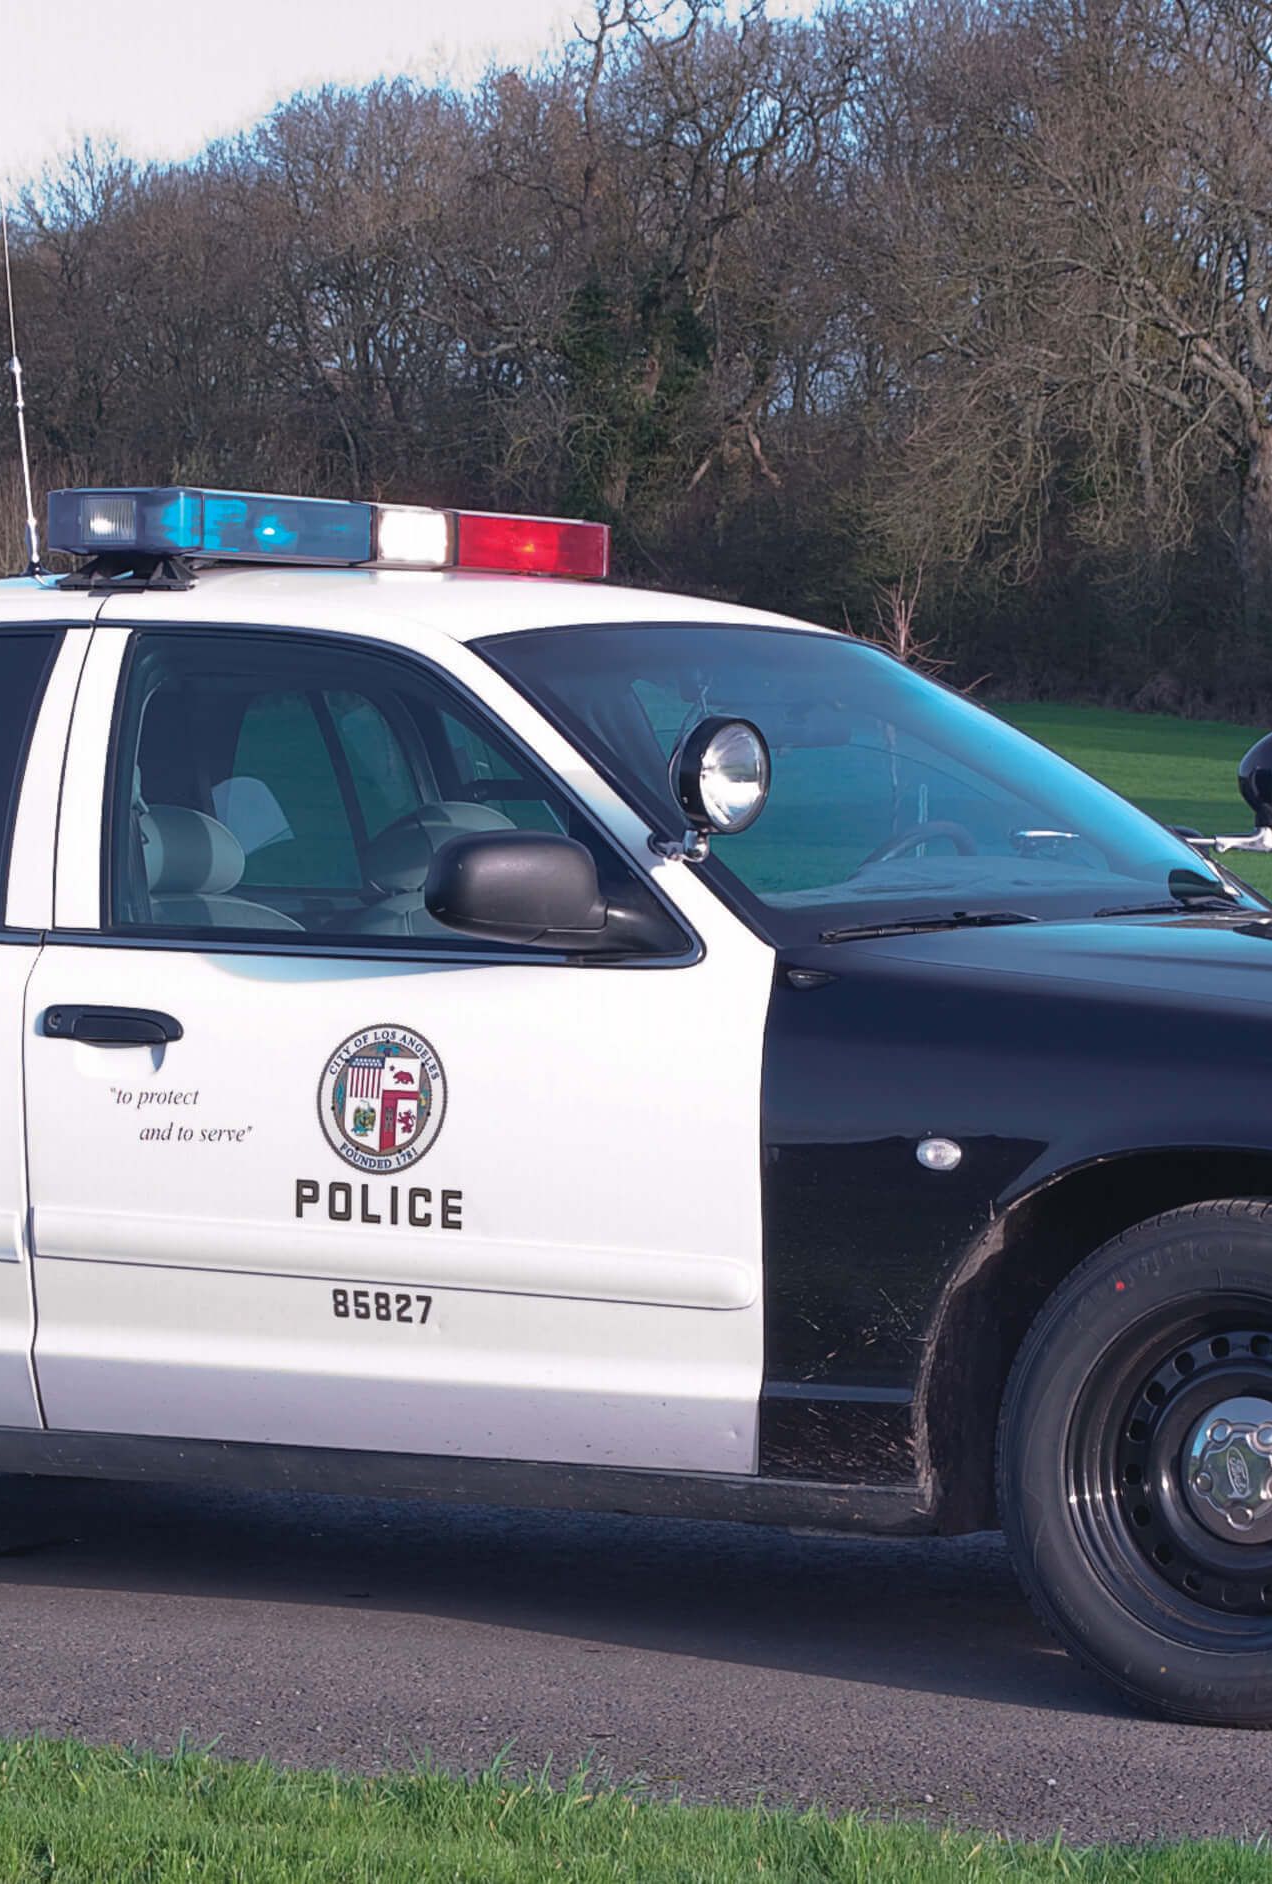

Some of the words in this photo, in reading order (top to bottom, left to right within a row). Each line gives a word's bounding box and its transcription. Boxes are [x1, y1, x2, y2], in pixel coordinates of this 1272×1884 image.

[329, 1046, 351, 1076] CITY
[354, 1034, 370, 1048] OF
[374, 1030, 396, 1041] LOS
[400, 1034, 440, 1081] ANGELES
[136, 1089, 199, 1110] protect
[139, 1122, 173, 1141] and
[177, 1126, 194, 1141] to
[199, 1125, 253, 1142] serve"
[339, 1142, 392, 1169] FOUNDED
[396, 1147, 418, 1166] 1781
[295, 1179, 462, 1230] POLICE
[332, 1289, 432, 1324] 85827
